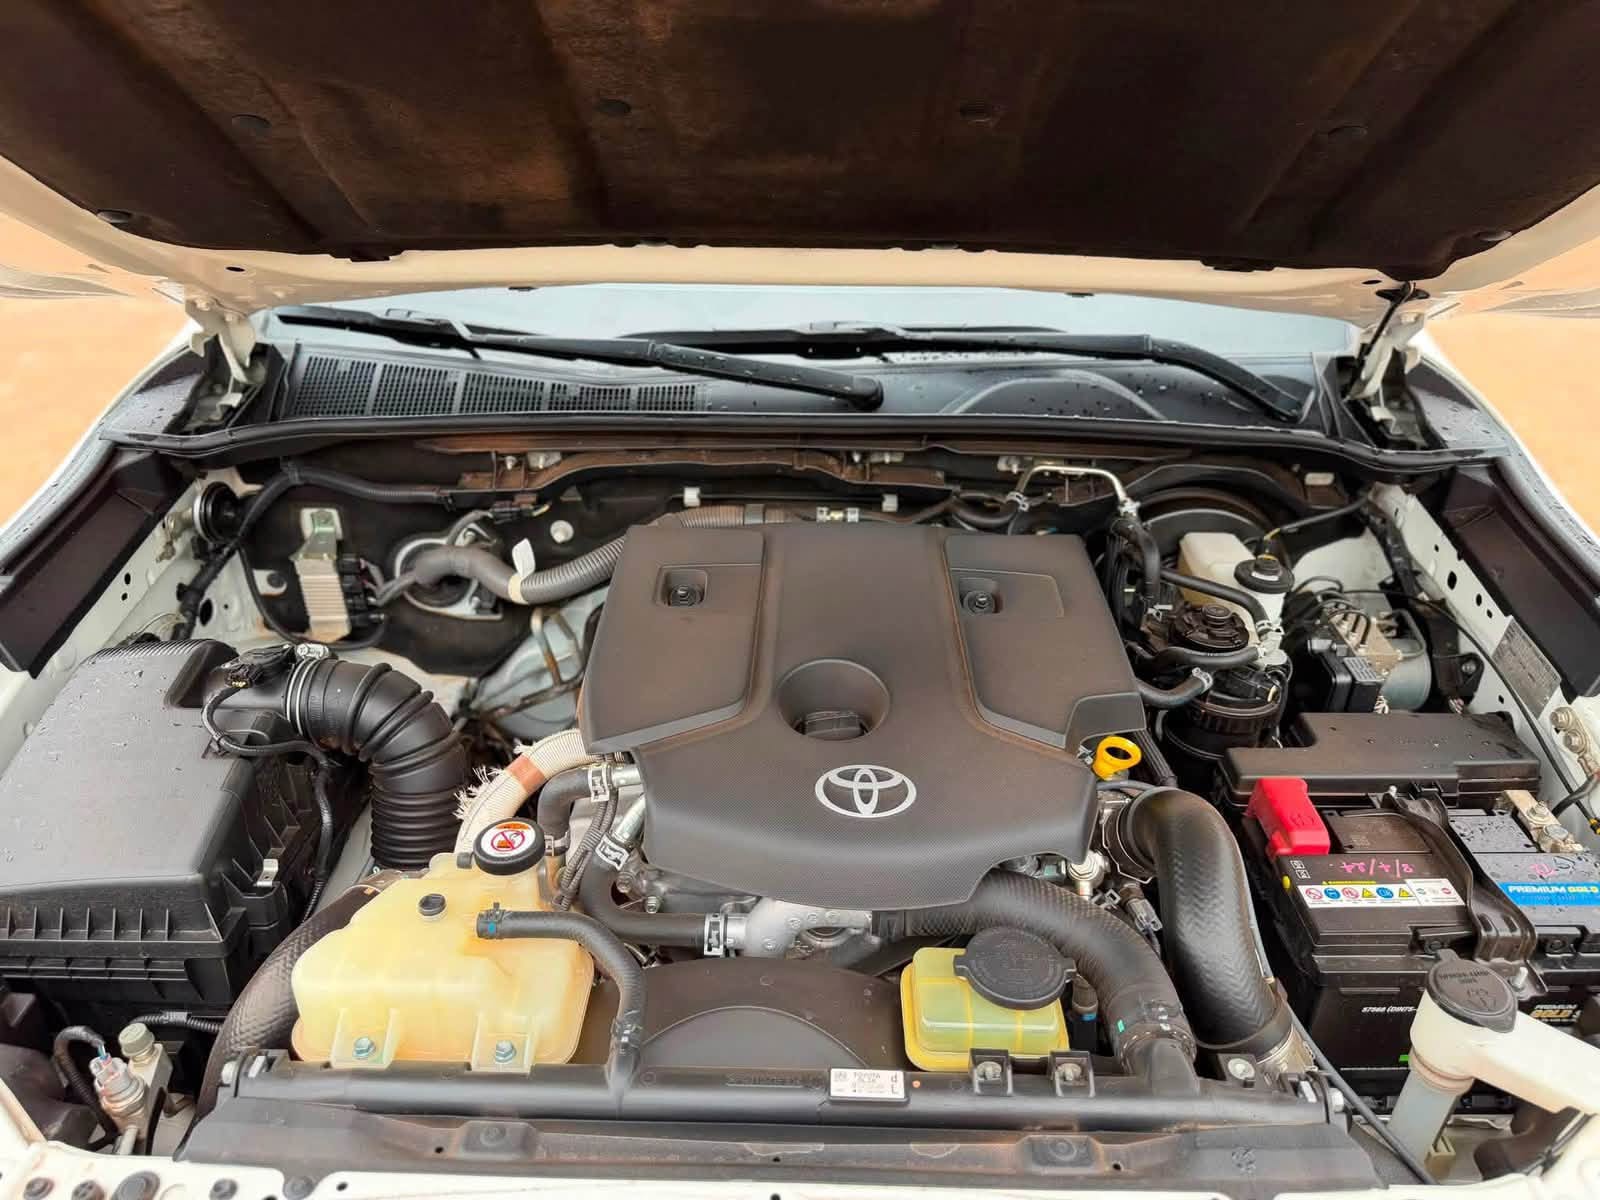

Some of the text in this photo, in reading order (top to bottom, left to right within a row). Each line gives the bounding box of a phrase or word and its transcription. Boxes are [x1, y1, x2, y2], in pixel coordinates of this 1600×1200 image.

[1507, 885, 1599, 894] PREMIUM GOLD
[1530, 1009, 1573, 1018] GOLD
